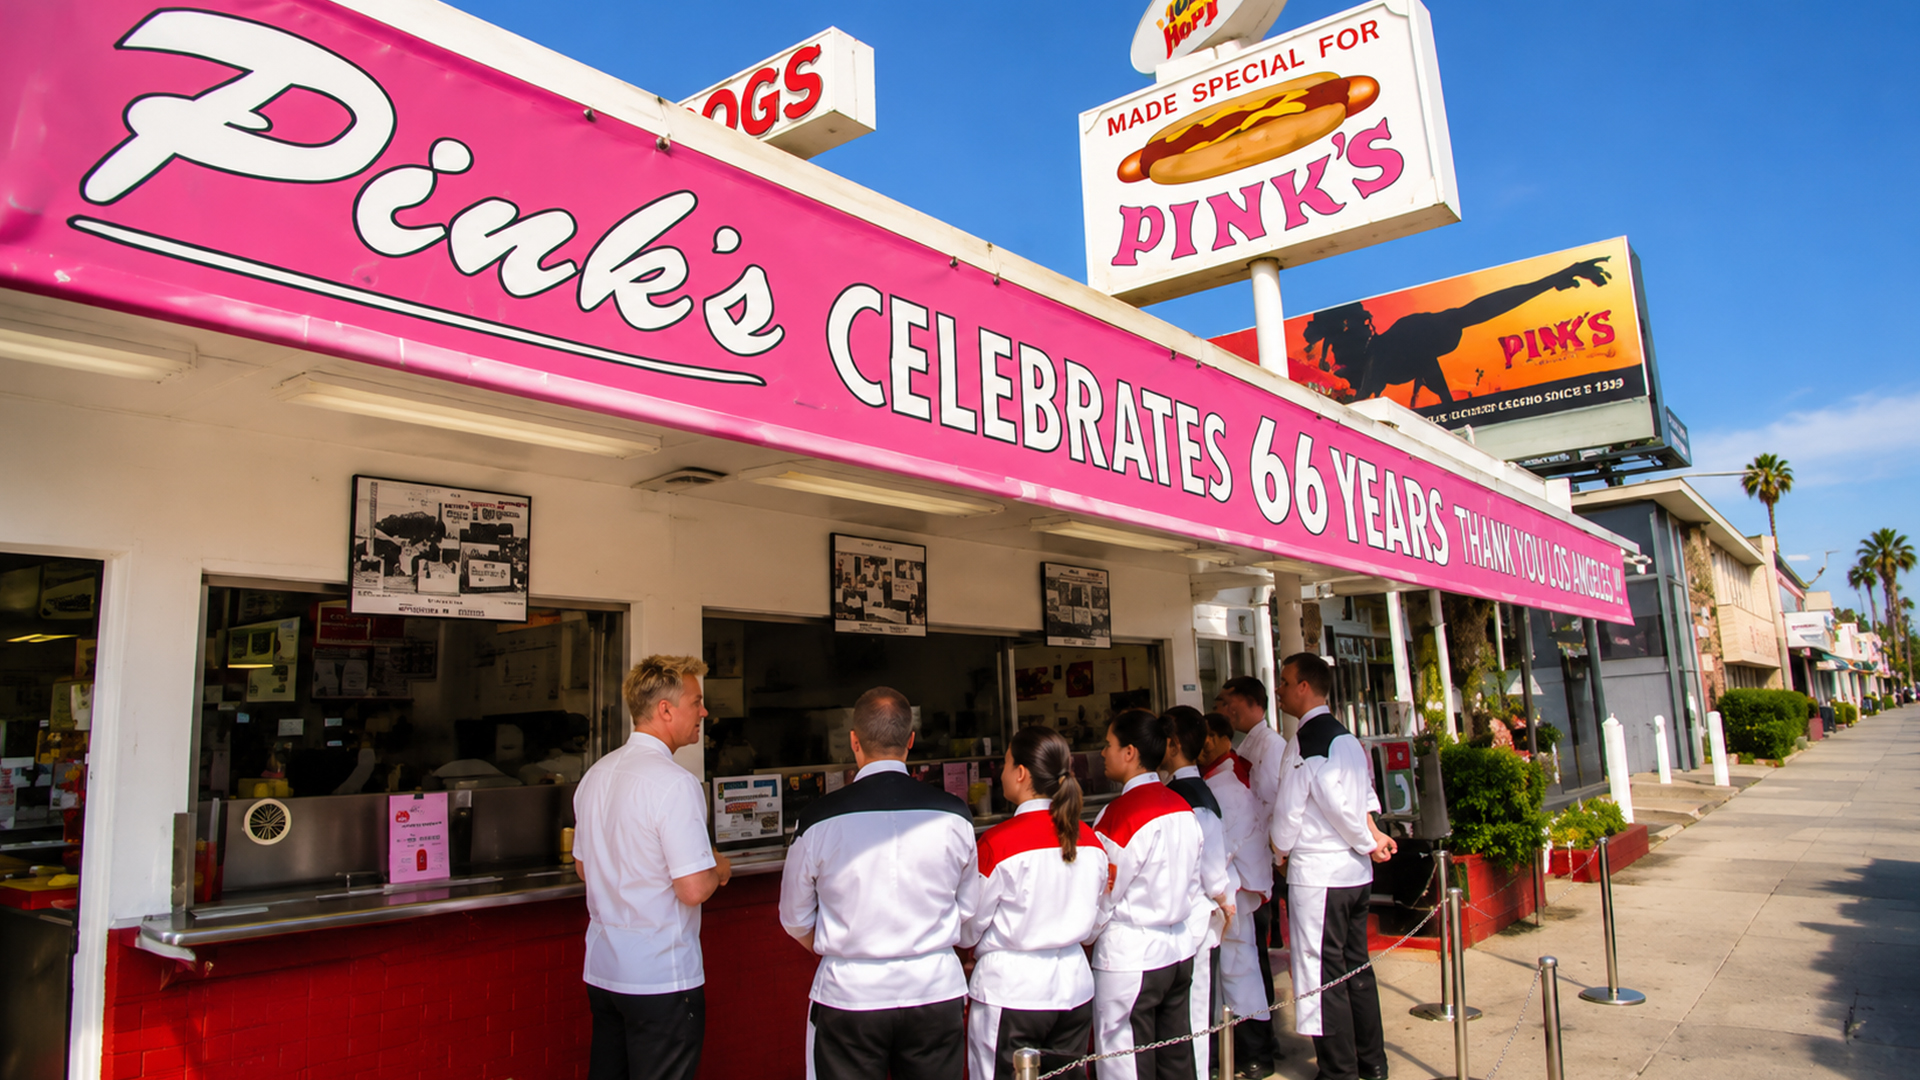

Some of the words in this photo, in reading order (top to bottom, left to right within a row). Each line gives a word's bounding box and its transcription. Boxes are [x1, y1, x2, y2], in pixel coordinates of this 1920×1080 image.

[686, 43, 823, 137] OGS
[1106, 93, 1178, 136] MADE
[1192, 49, 1305, 103] SPECIAL
[1318, 20, 1380, 58] FOR
[79, 6, 786, 357] Pink's
[1110, 116, 1405, 267] PINK'S
[1497, 309, 1616, 370] PINK'S
[826, 282, 1234, 503] CELEBRATES
[1250, 415, 1329, 537] 66
[1328, 446, 1451, 568] YEARS
[1453, 503, 1517, 577] THANK
[1513, 527, 1546, 586] YOU
[1545, 540, 1572, 593] LOS
